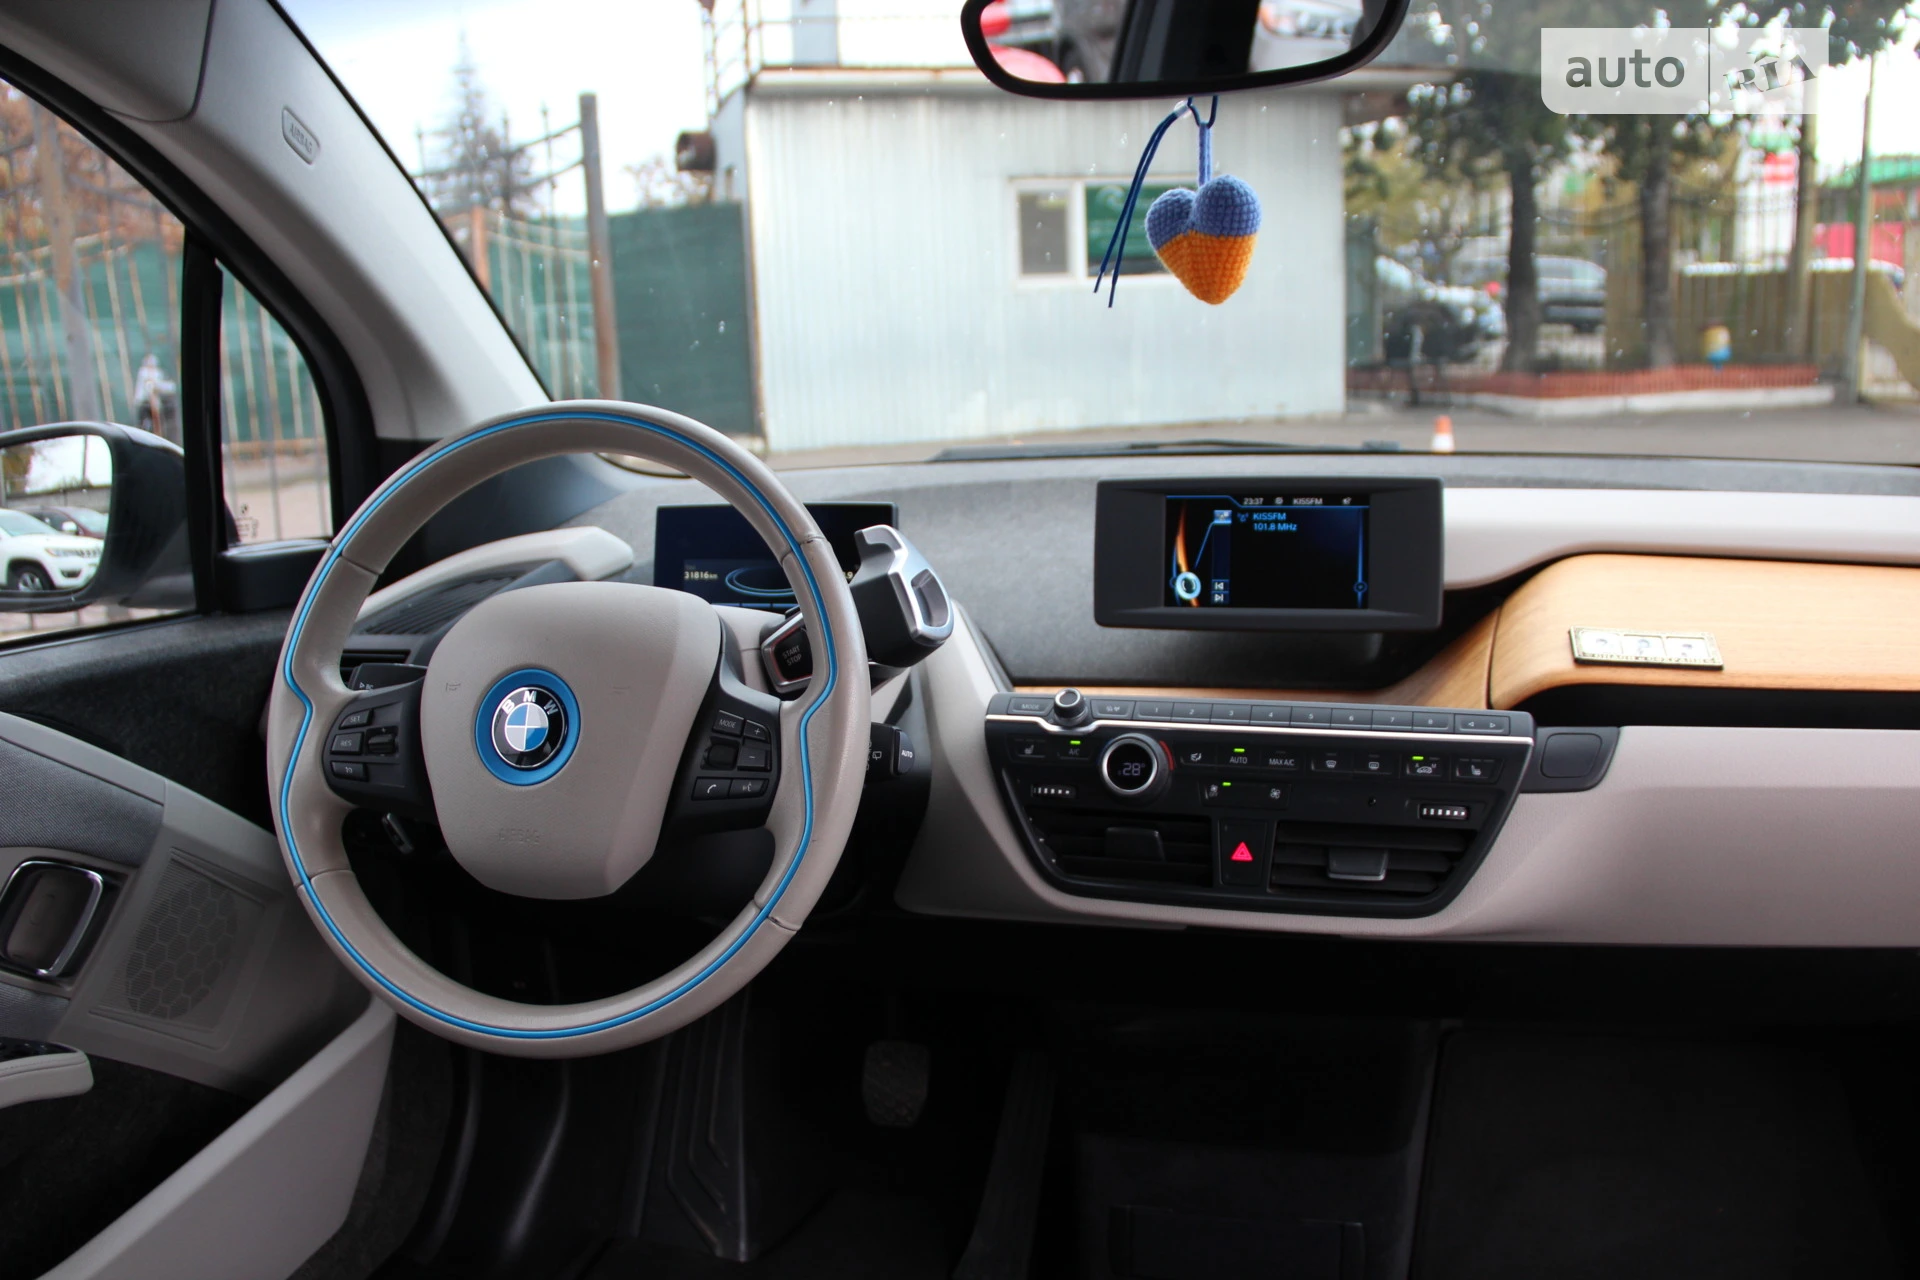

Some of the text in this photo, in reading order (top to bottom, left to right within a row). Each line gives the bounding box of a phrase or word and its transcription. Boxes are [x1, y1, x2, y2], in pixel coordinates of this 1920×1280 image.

[1243, 497, 1264, 505] 23:37
[1293, 497, 1323, 505] KISSFM
[1253, 512, 1287, 521] KISSFM
[1253, 522, 1298, 532] 101.8 MHz
[783, 645, 800, 659] START
[786, 653, 802, 667] STOP
[502, 690, 559, 715] BMW
[1021, 703, 1041, 711] MODE
[350, 715, 361, 723] SET
[719, 717, 736, 729] MODE
[340, 739, 352, 747] RES
[901, 749, 913, 760] AUTO
[1068, 748, 1080, 756] A/C
[1229, 756, 1248, 765] AUTO
[1268, 758, 1295, 767] MAX A/C
